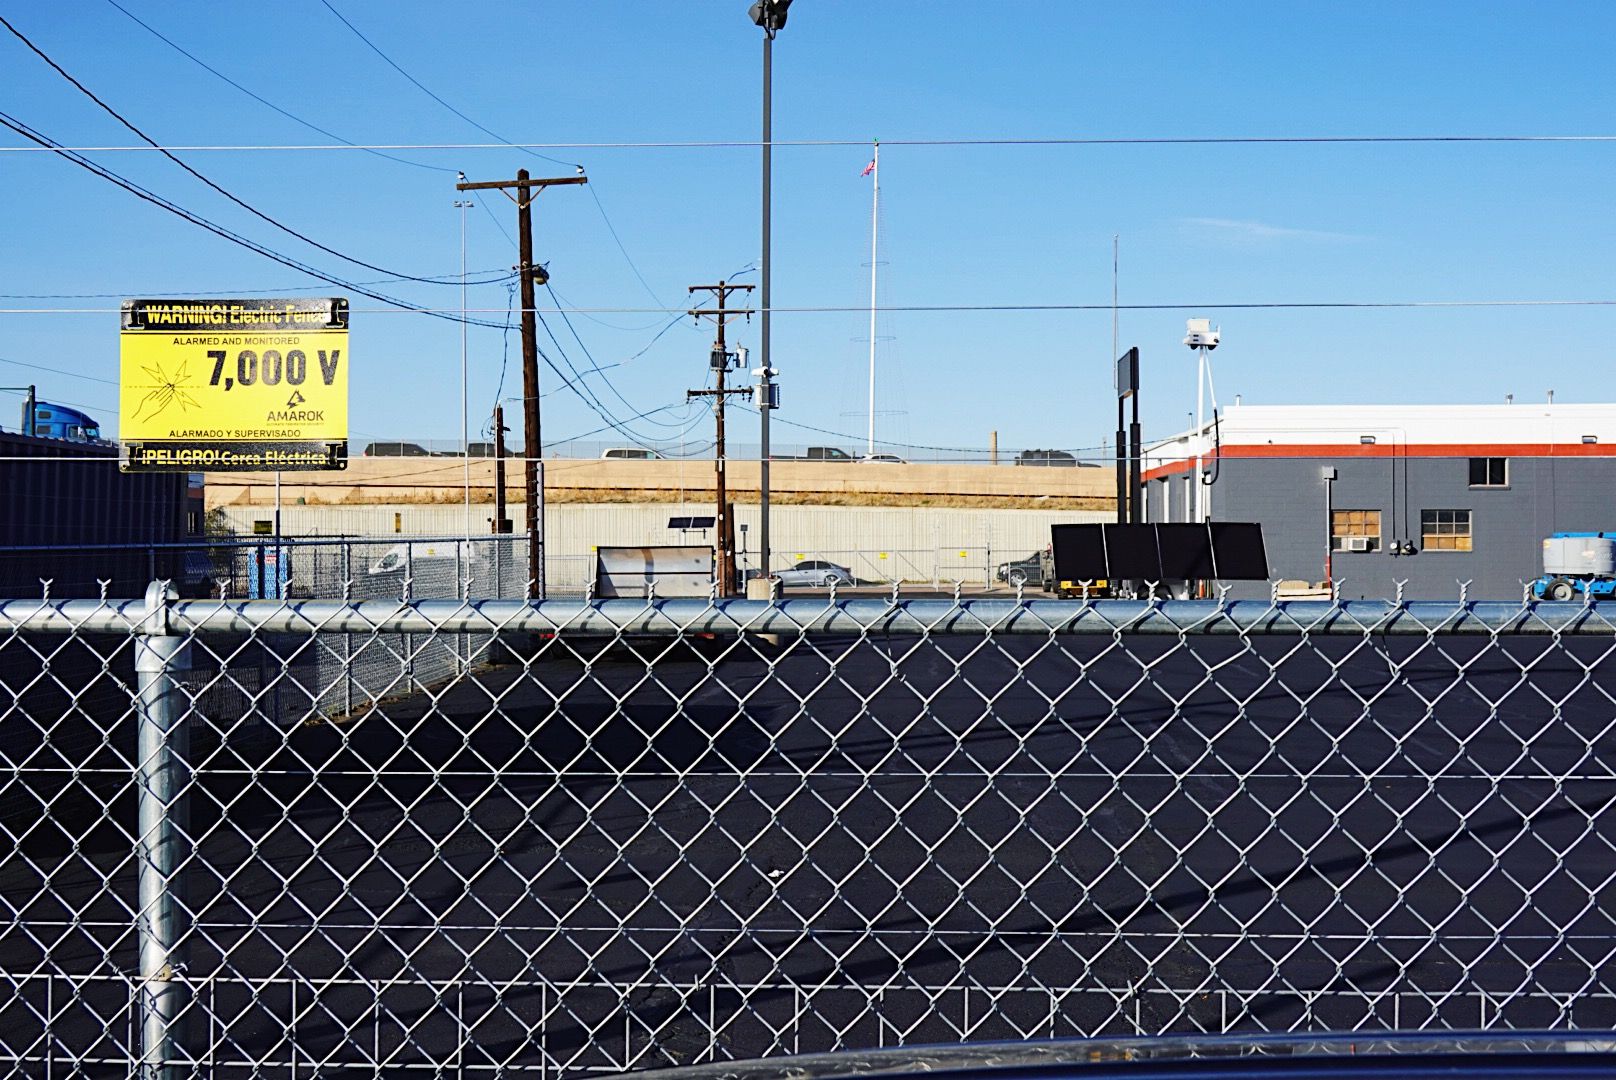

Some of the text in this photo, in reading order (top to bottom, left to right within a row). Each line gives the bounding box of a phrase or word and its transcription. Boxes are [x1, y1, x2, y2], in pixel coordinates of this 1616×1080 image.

[146, 305, 227, 324] WARNING!
[231, 306, 282, 324] Electric
[173, 337, 300, 345] ALARMED AND MONITORED
[207, 350, 340, 391] 7,000 V
[267, 410, 324, 421] AMAROK
[169, 430, 301, 438] ALARMADO Y SUPERVISADO
[142, 450, 326, 465] ¡PELIGRO! Cerca Eléctrica
